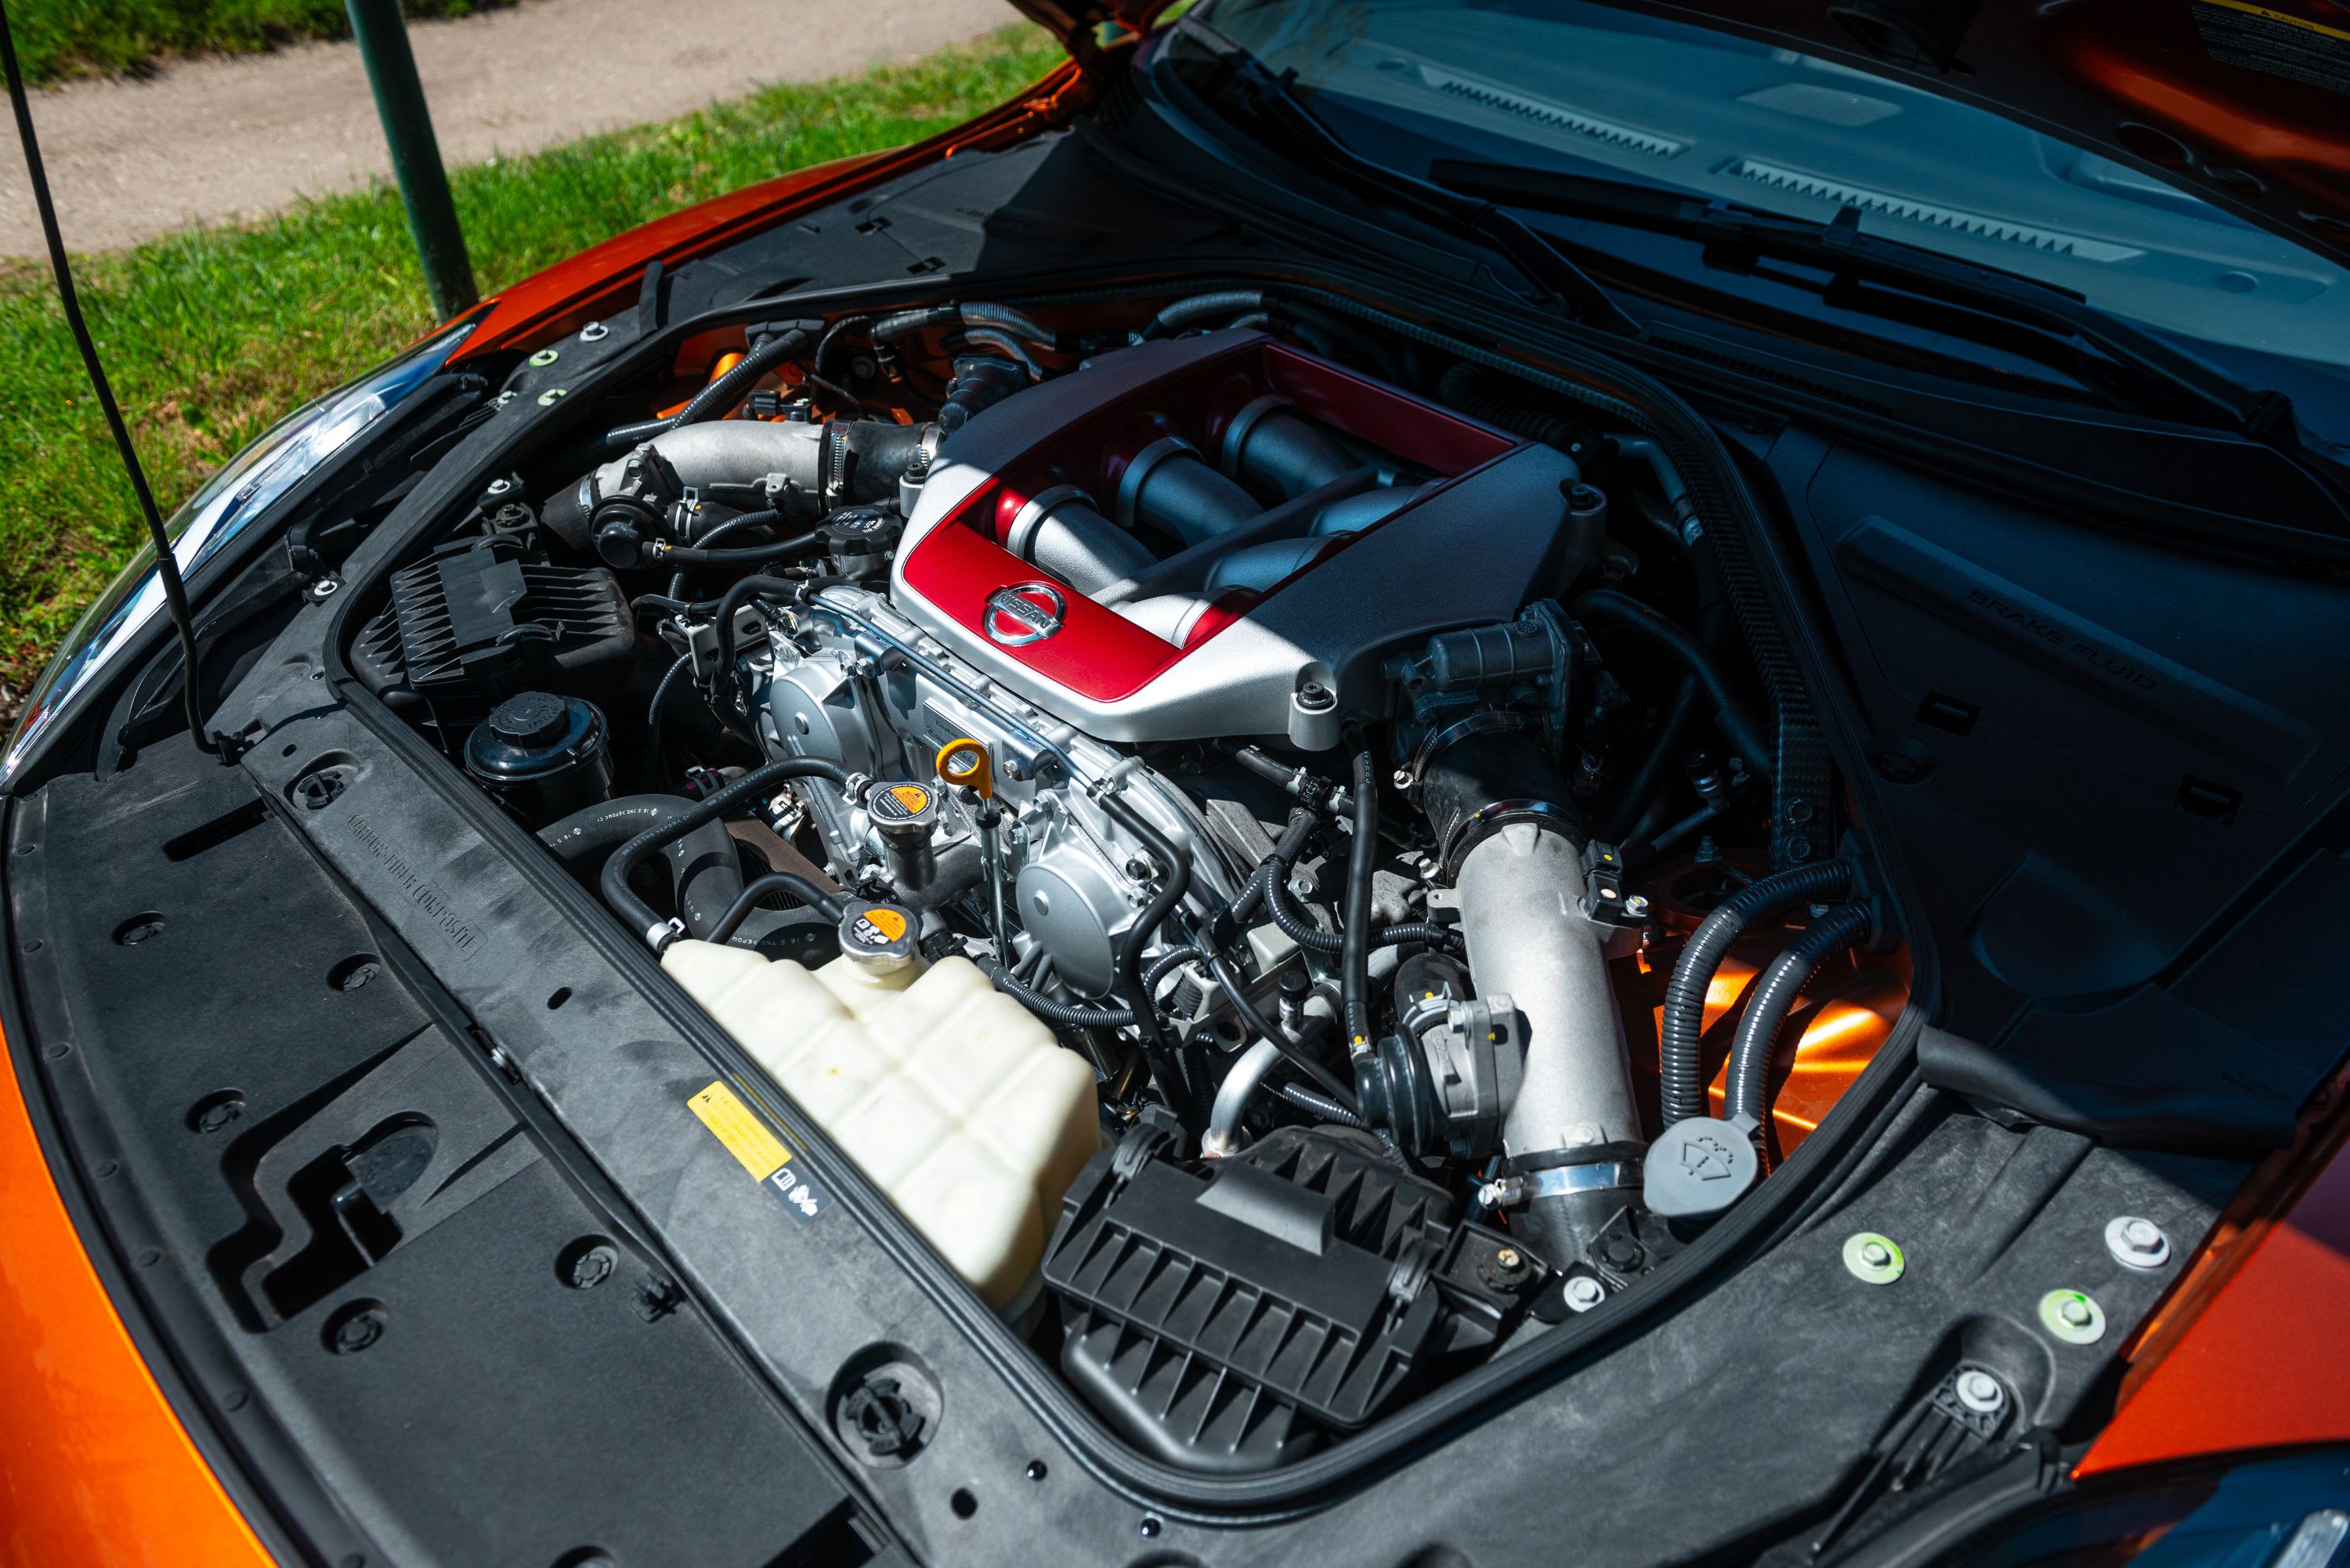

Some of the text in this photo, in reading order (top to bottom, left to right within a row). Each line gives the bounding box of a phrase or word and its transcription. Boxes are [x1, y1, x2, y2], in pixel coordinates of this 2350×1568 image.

[2274, 13, 2315, 31] CAUTION
[996, 591, 1052, 630] NISSAN
[1968, 590, 2157, 690] BRAKE FLUID
[412, 884, 477, 954] COMPOSITE
